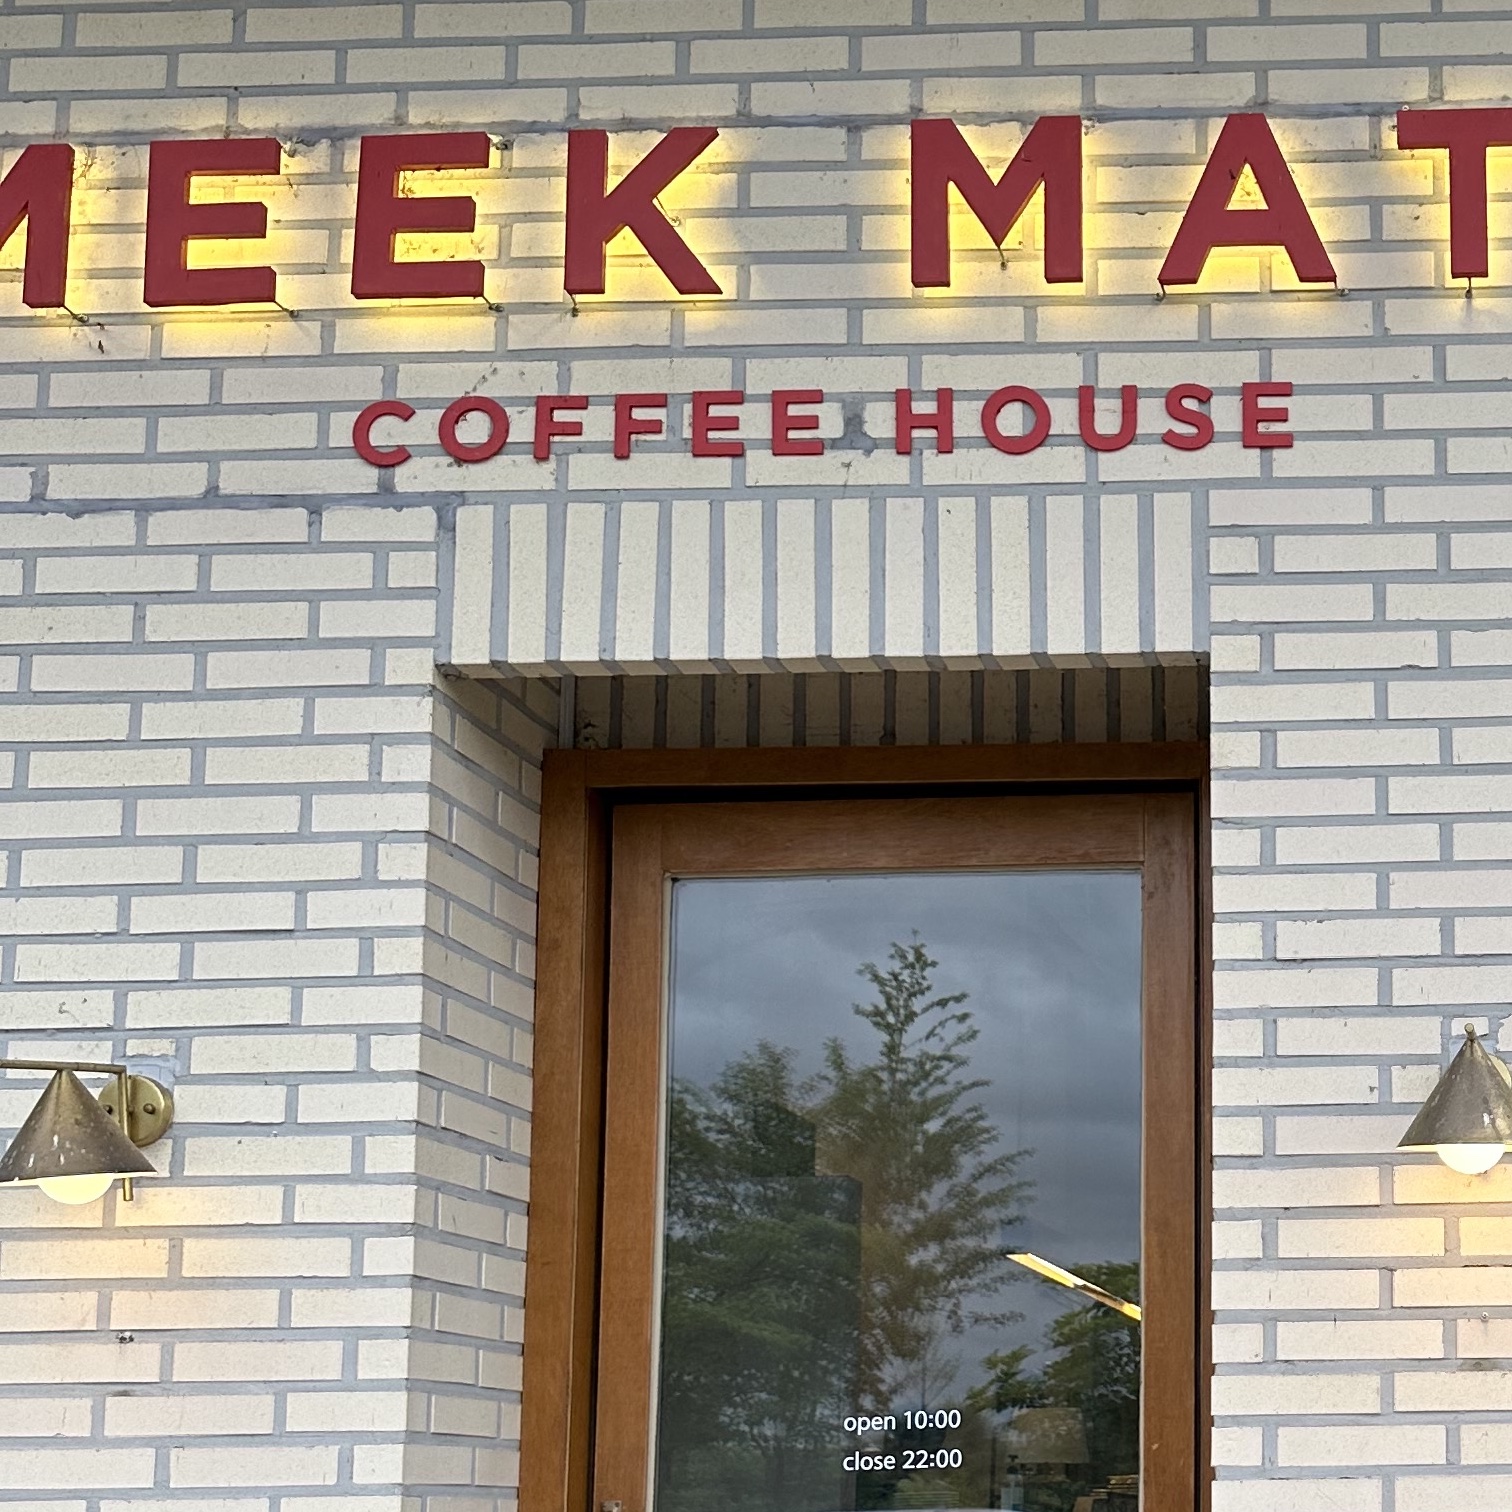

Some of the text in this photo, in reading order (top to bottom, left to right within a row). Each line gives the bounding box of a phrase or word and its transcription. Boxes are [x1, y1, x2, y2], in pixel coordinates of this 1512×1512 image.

[352, 382, 1293, 467] COFFEE HOUSE
[843, 1409, 962, 1436] open 10:00
[842, 1448, 963, 1471] close 22:00
